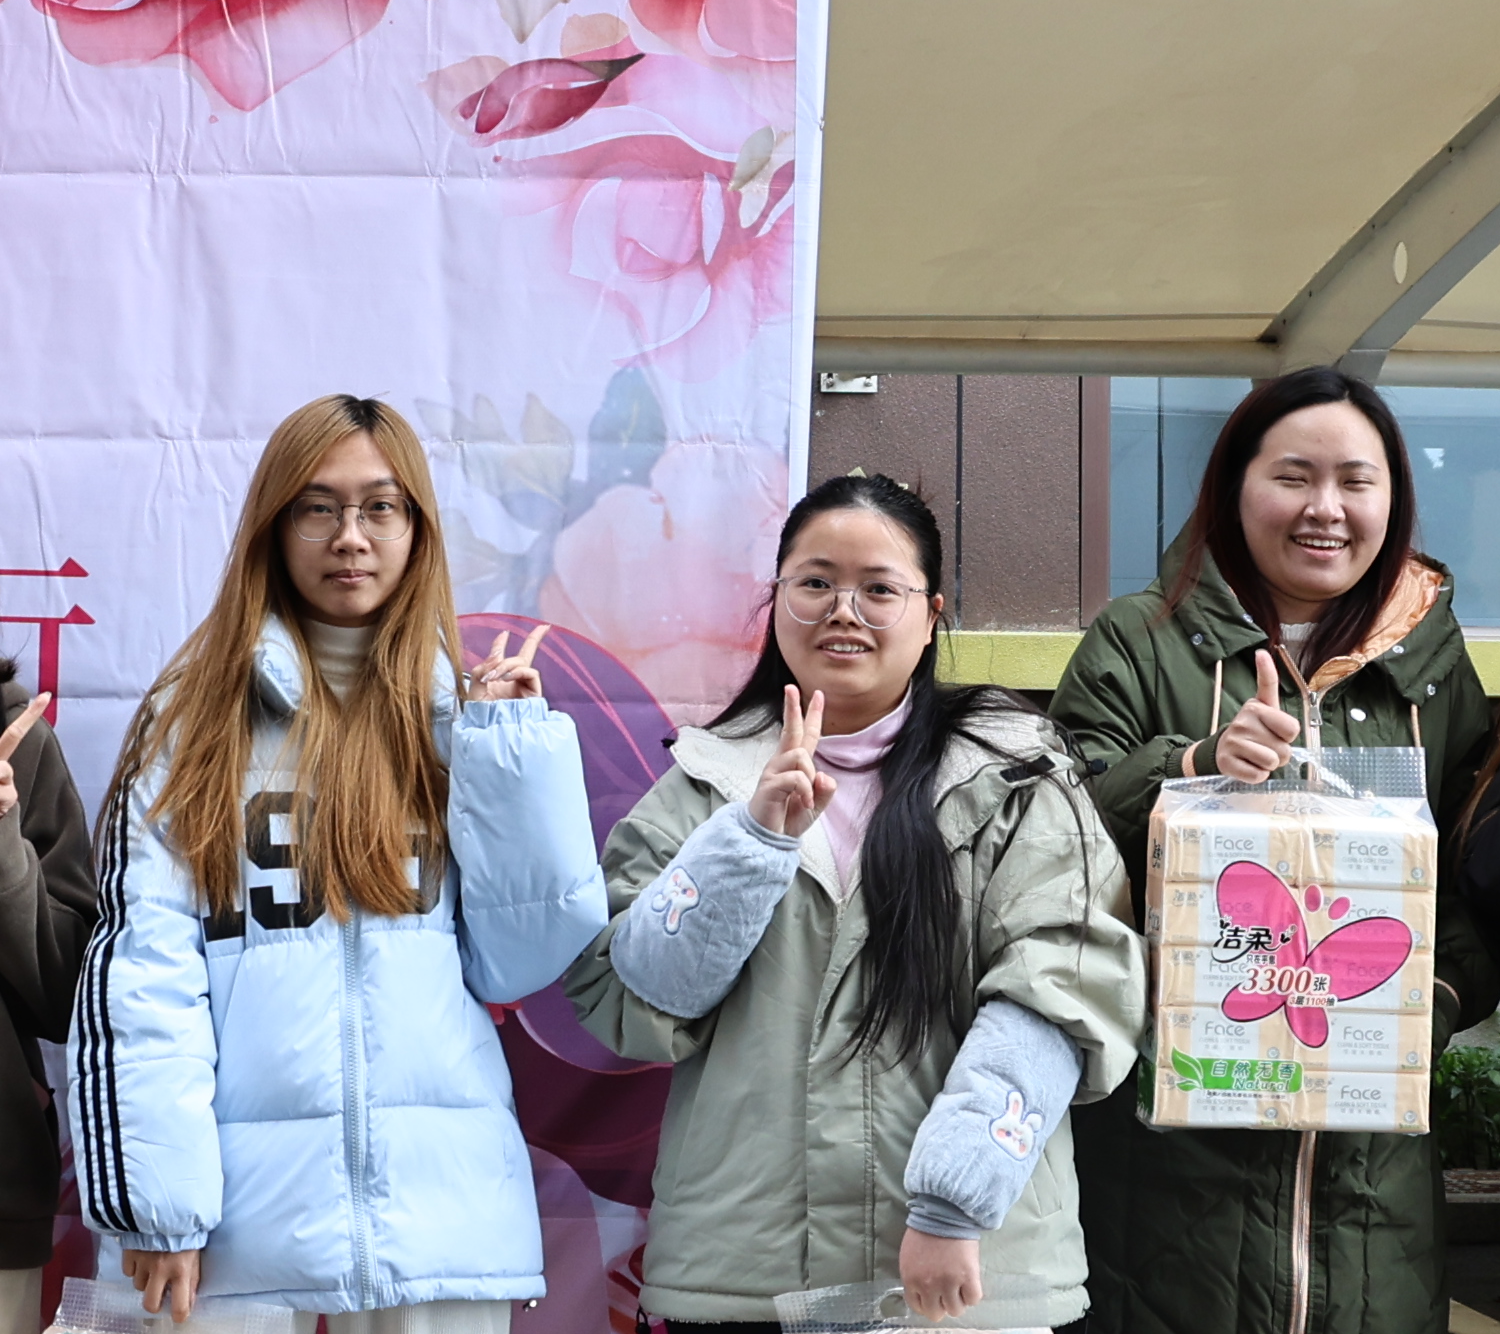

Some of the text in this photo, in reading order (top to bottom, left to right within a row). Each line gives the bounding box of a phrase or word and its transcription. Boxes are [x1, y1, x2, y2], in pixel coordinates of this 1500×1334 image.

[1213, 836, 1254, 851] Face
[1348, 841, 1388, 857] Face
[1242, 968, 1328, 993] 3300张
[1204, 1022, 1244, 1037] Face
[1343, 1026, 1384, 1042] Face
[1211, 1060, 1296, 1078] 自然无香
[1233, 1078, 1290, 1091] Natural
[1340, 1085, 1381, 1101] Face
